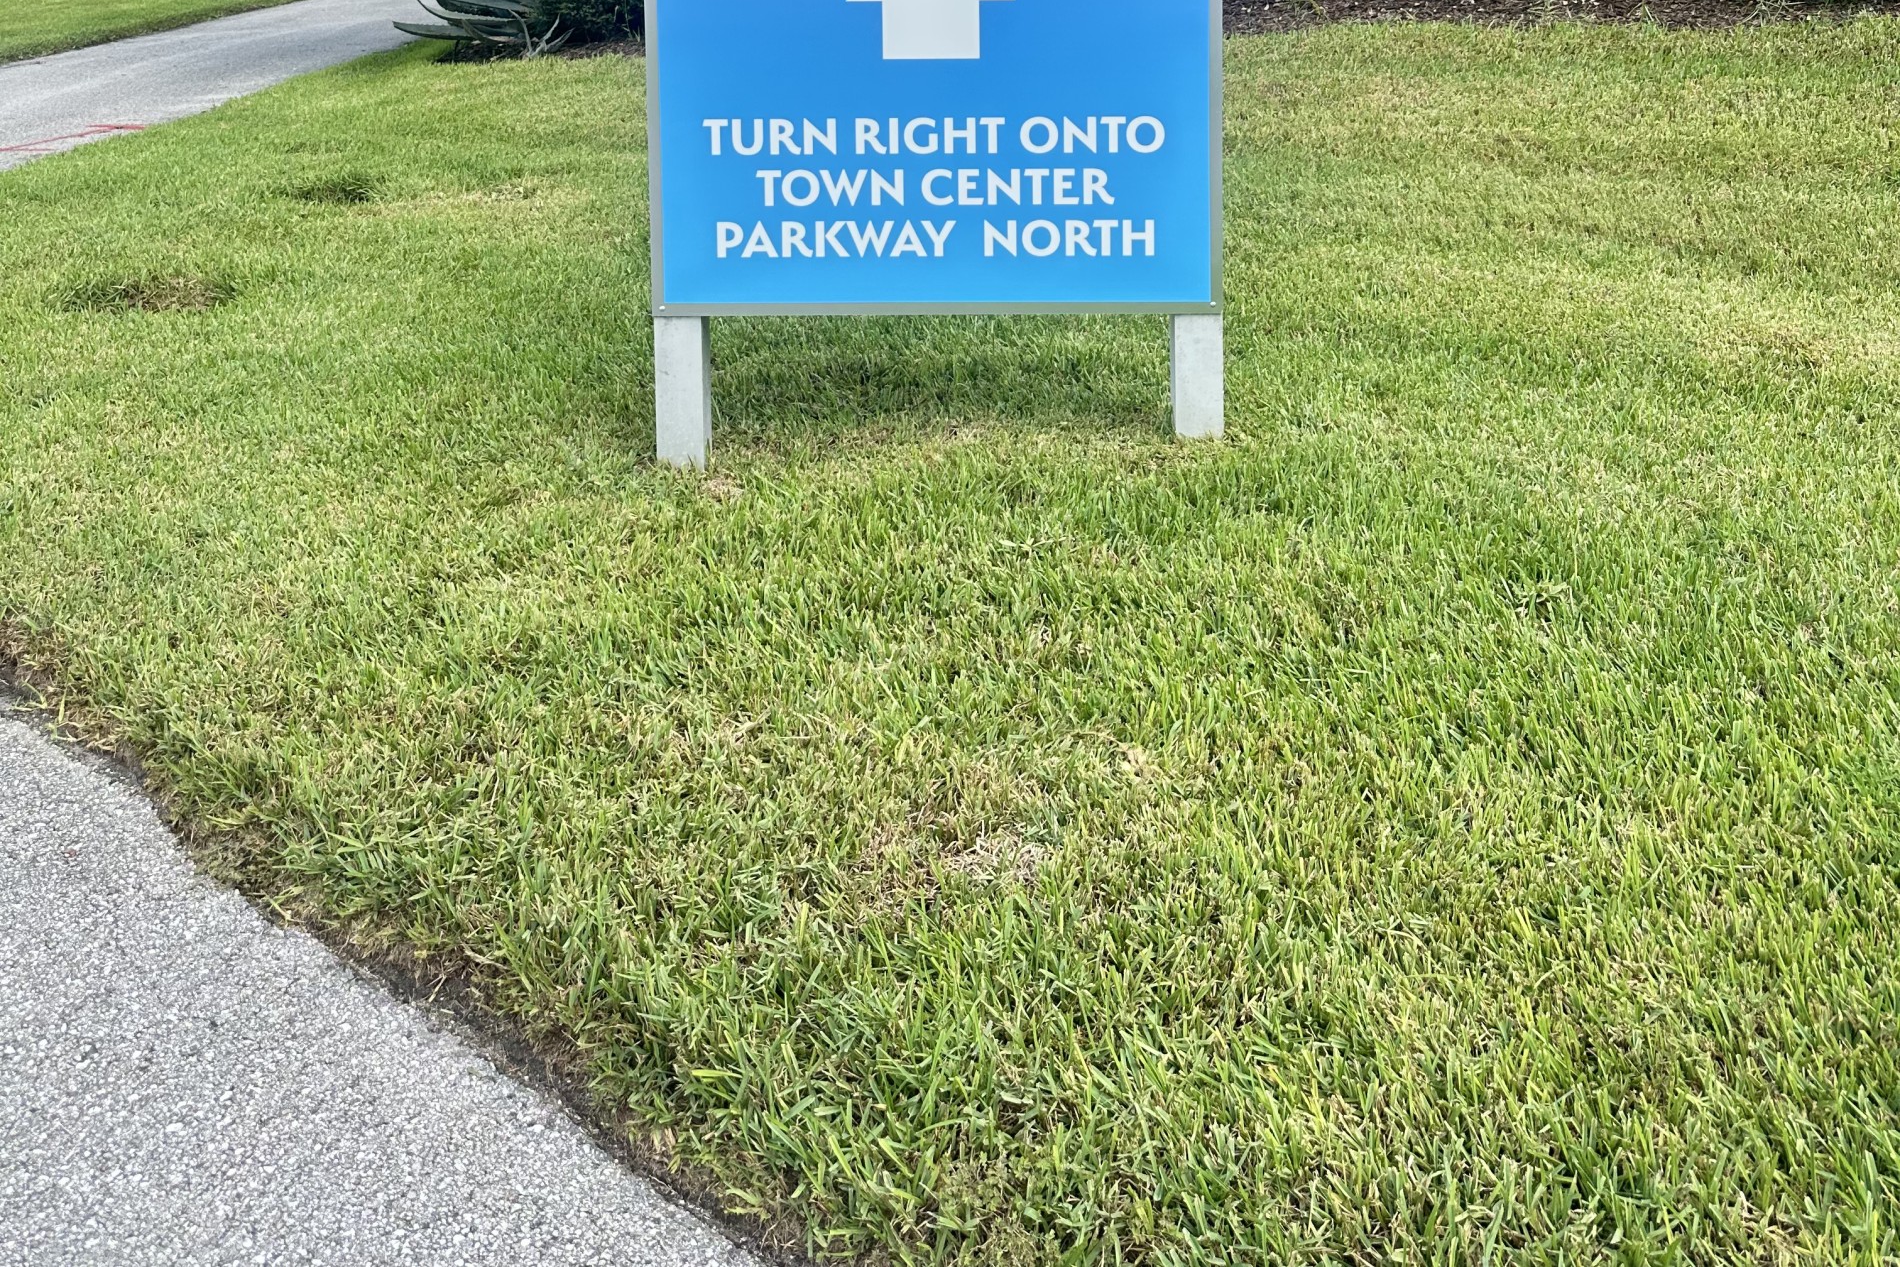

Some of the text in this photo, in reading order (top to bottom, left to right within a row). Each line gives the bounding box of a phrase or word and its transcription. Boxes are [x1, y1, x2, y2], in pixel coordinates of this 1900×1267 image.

[702, 115, 1166, 156] TURN RIGHT ONTO
[755, 167, 1115, 207] TOWN CENTER
[716, 219, 1155, 259] PARKWAY NORTH
